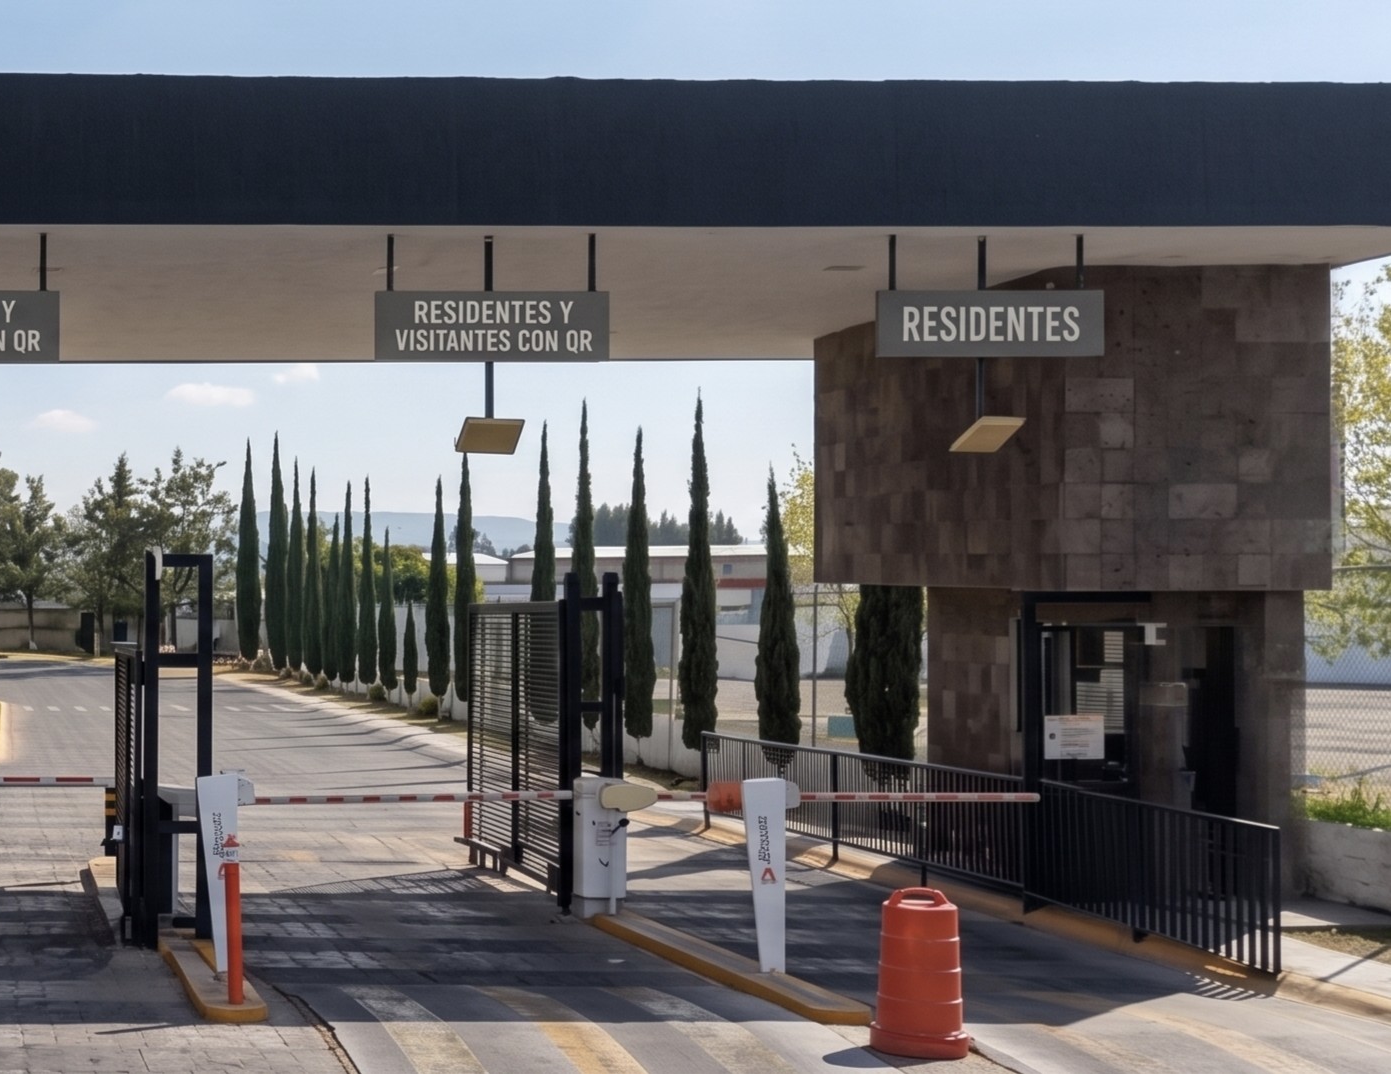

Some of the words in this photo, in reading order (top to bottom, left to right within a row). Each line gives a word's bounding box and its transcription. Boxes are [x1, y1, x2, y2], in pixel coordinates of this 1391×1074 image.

[1, 300, 16, 323] Y
[414, 300, 552, 325] RESIDENTES
[559, 300, 574, 324] Y
[902, 305, 1081, 343] RESIDENTES
[13, 329, 41, 354] QR
[395, 329, 511, 352] VISITANTES
[518, 329, 559, 352] CON
[565, 329, 593, 354] QR
